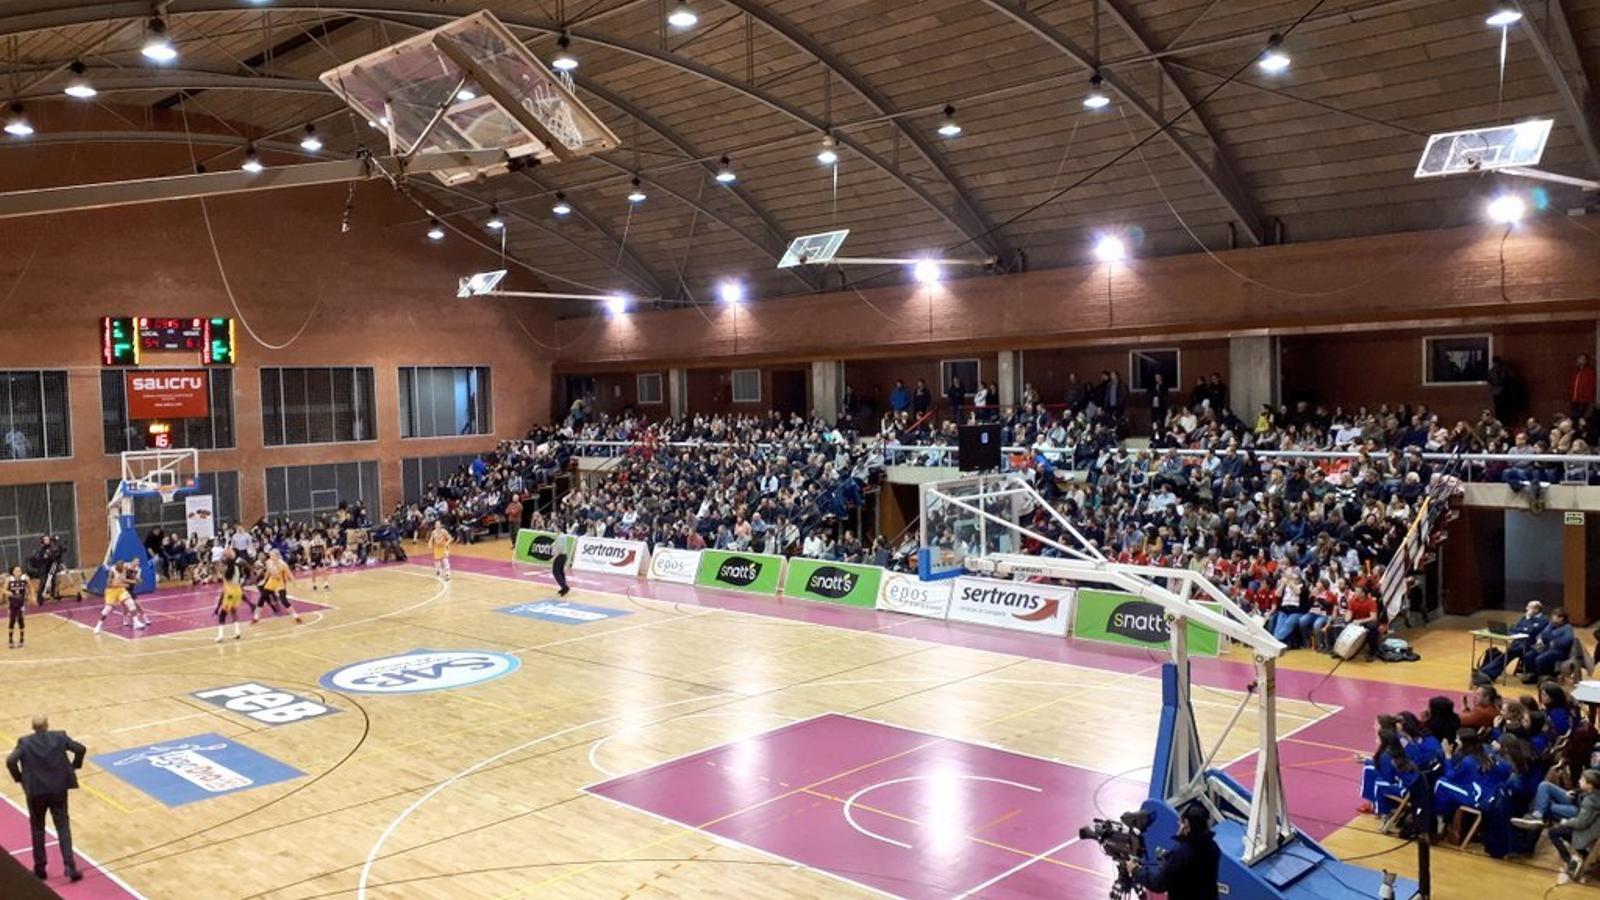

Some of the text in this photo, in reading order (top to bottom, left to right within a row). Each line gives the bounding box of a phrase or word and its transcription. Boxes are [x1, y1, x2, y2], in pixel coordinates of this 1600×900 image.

[155, 434, 168, 448] 16
[581, 543, 627, 559] sertrans
[657, 560, 684, 573] epos
[720, 564, 758, 581] snatt's
[810, 573, 852, 592] snatt's
[890, 583, 928, 602] epos
[961, 586, 1041, 609] sertrans
